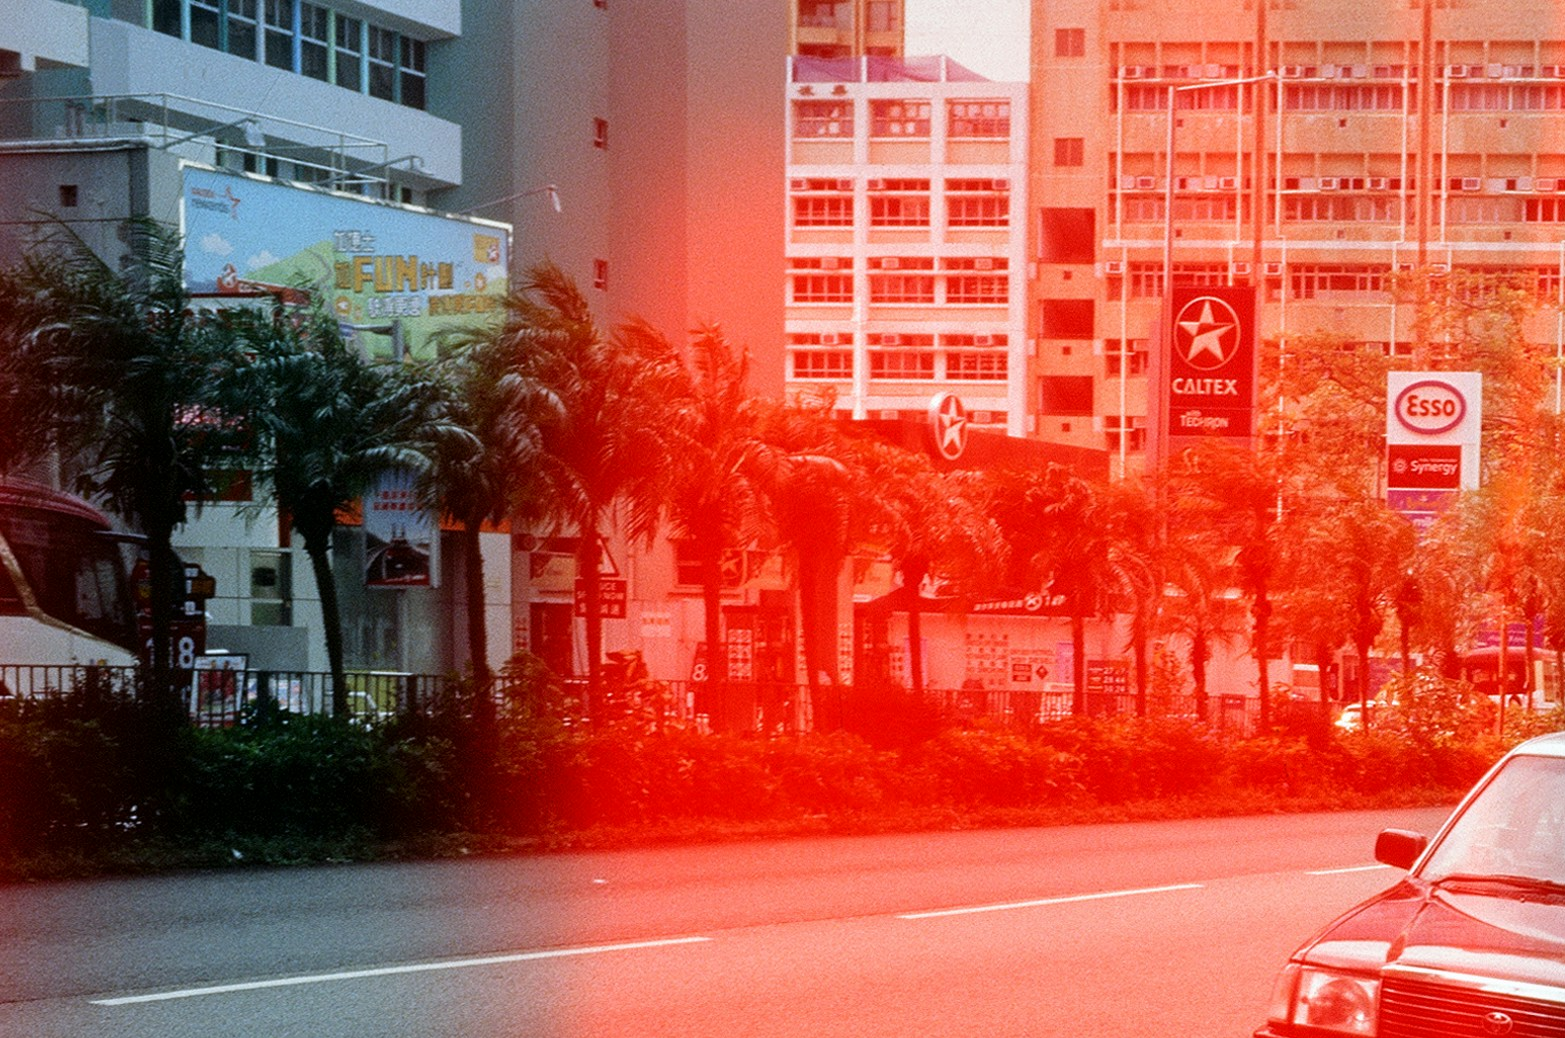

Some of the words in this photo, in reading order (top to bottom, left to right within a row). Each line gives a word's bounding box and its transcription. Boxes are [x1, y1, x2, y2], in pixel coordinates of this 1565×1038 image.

[1171, 377, 1239, 396] CALTEX
[1406, 393, 1457, 417] Esso
[1410, 459, 1458, 475] Synergy
